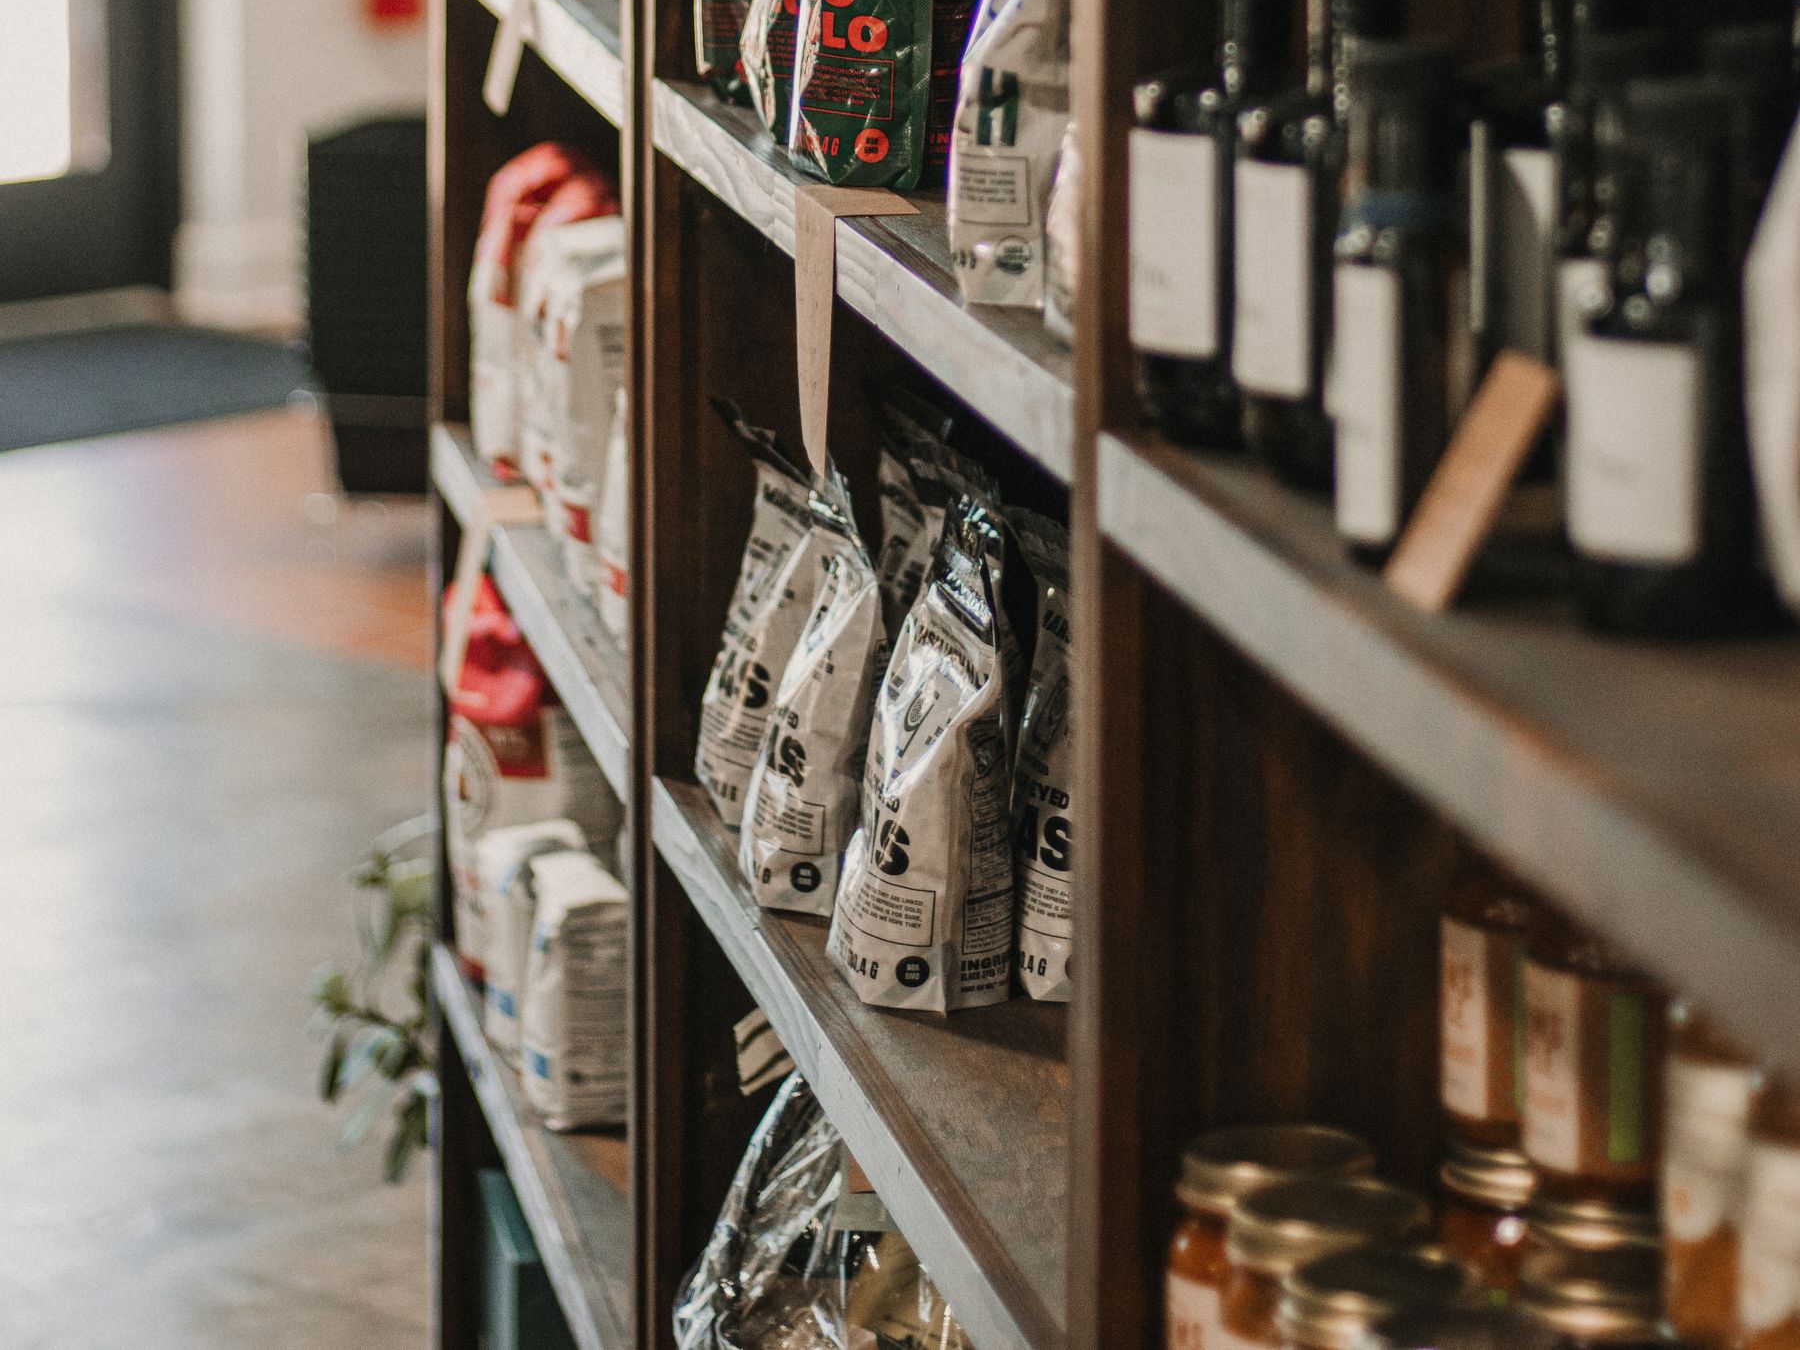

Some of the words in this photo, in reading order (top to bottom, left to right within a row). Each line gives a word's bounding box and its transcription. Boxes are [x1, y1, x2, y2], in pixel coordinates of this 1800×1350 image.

[821, 11, 888, 53] LO
[869, 961, 879, 980] G
[1037, 958, 1047, 976] G
